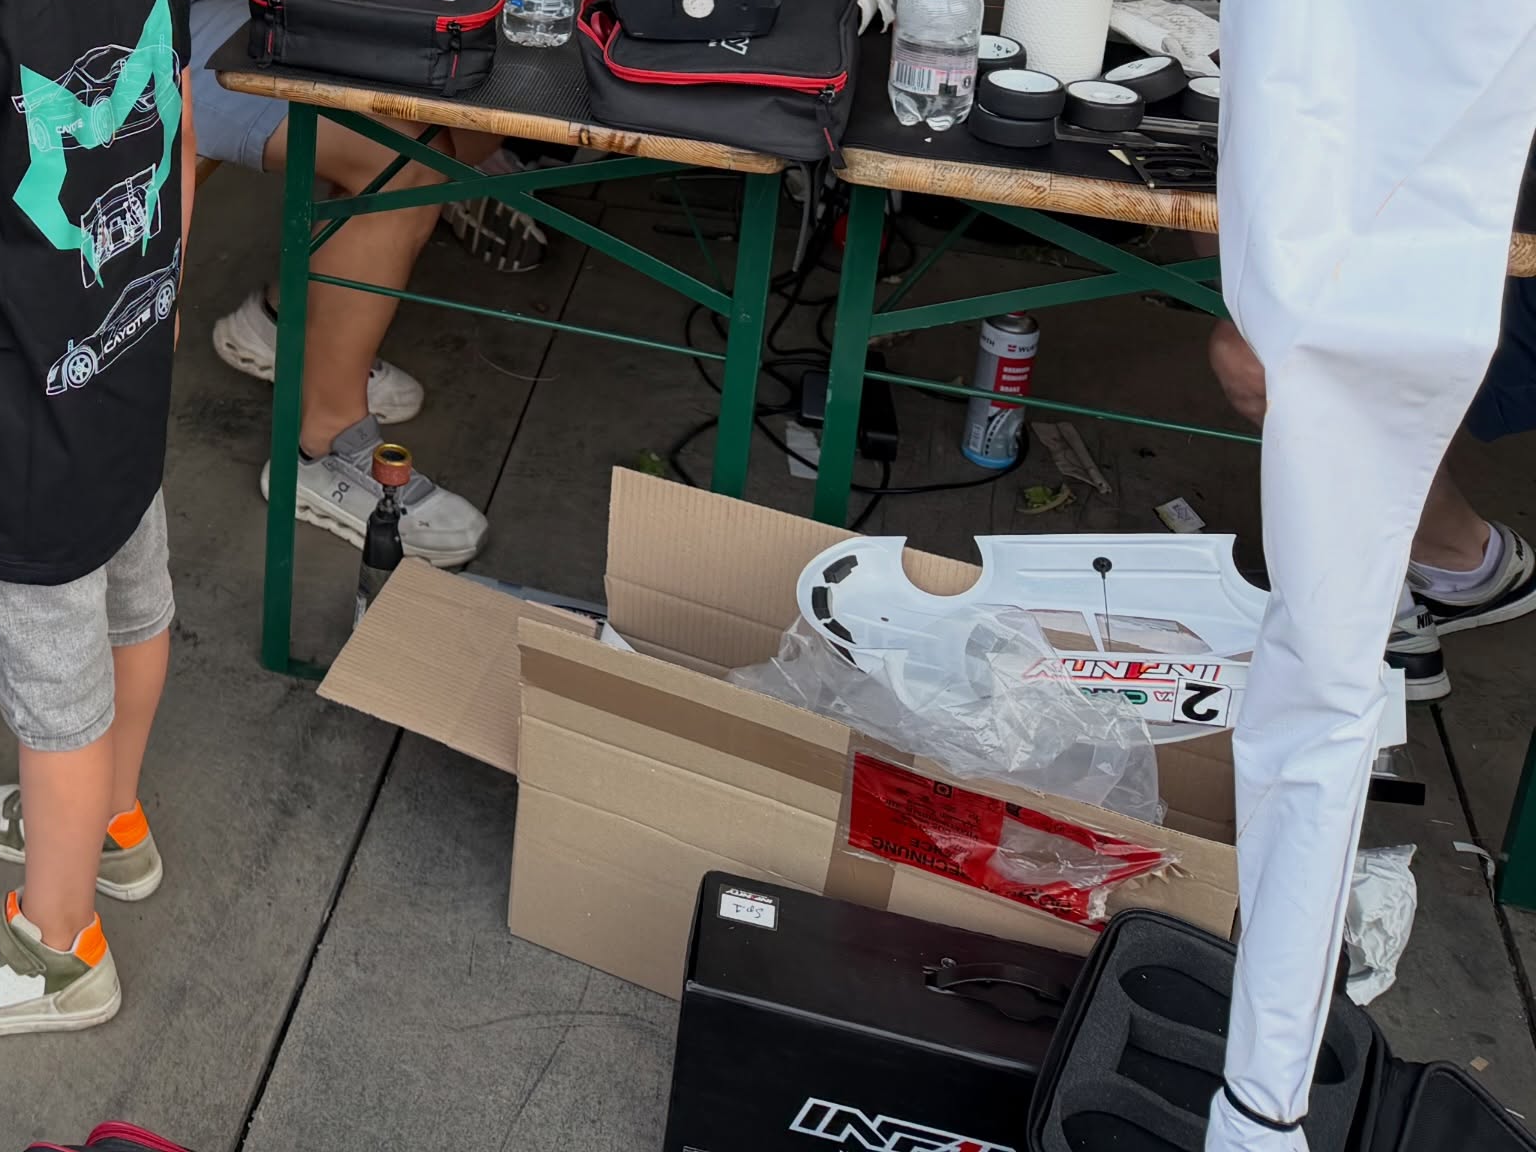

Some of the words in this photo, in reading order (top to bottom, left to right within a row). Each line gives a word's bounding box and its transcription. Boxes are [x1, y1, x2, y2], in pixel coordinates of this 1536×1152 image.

[104, 308, 151, 354] CAYOTE
[1181, 682, 1226, 723] 2
[871, 836, 966, 879] ECHNUNG
